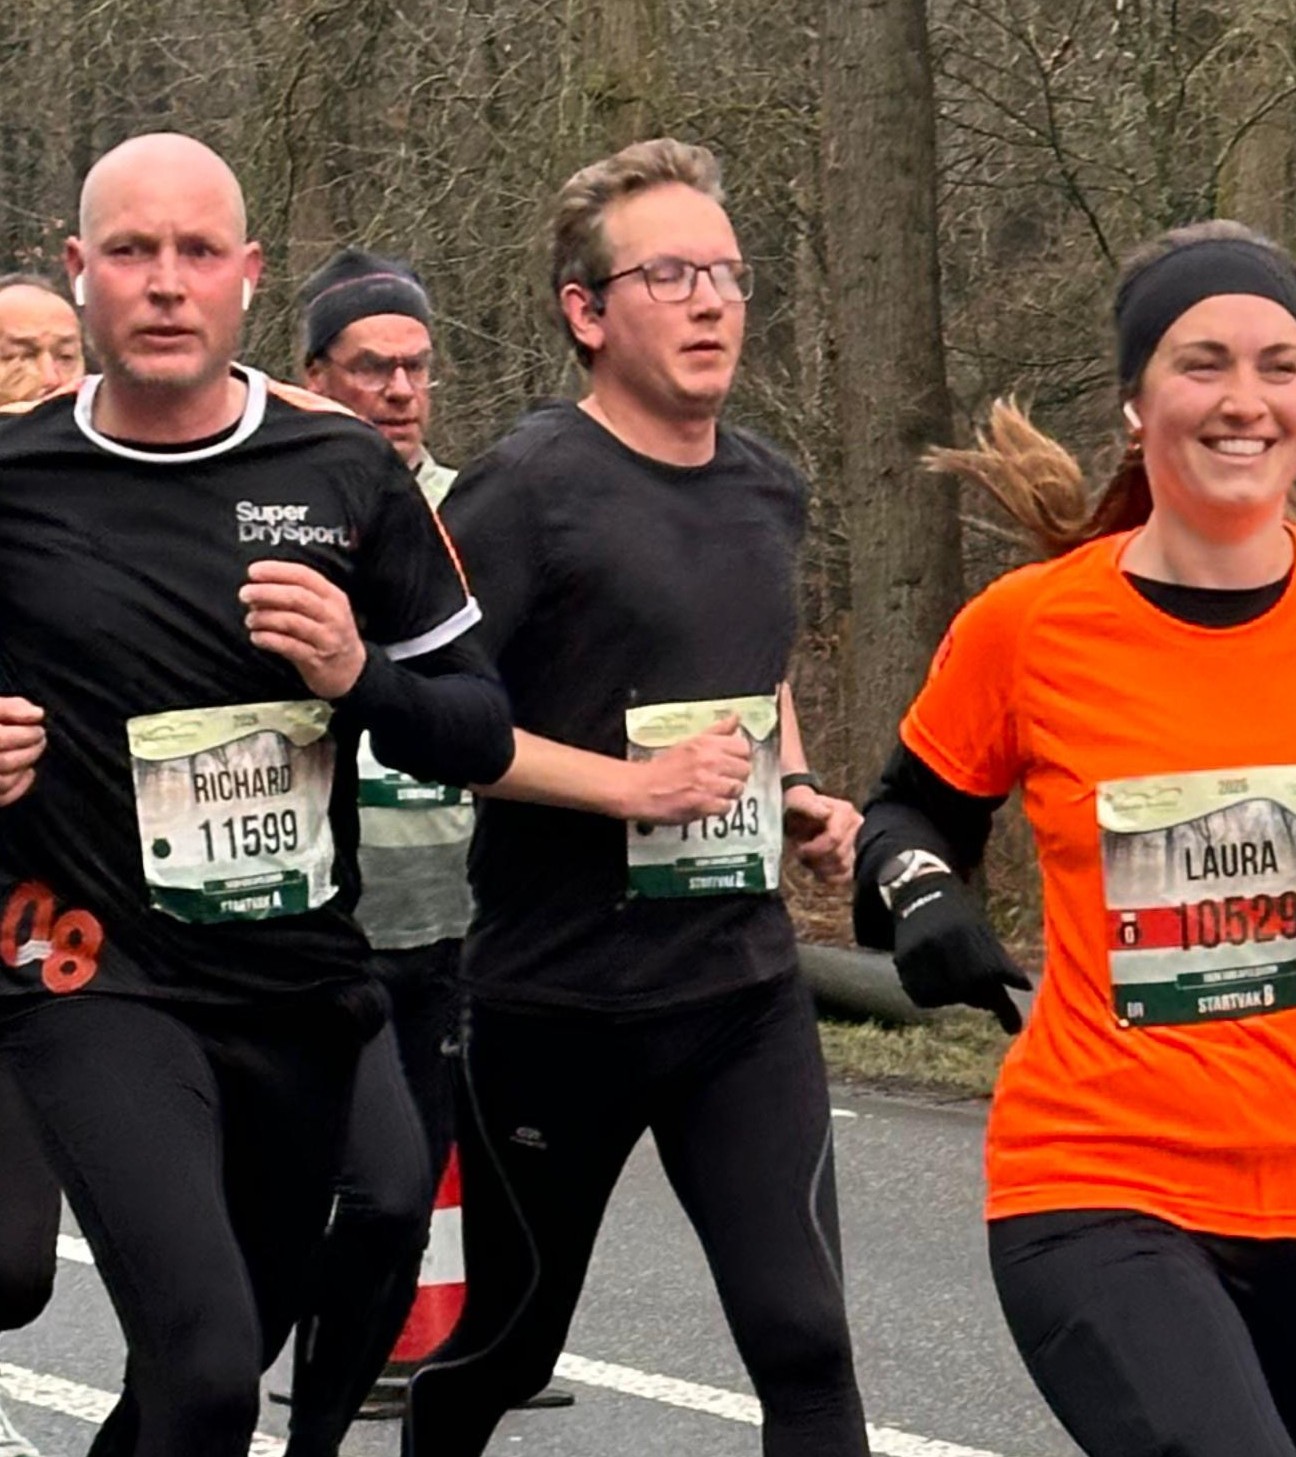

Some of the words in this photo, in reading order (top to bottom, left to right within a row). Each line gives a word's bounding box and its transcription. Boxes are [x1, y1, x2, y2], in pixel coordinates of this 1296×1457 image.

[235, 500, 309, 526] Super
[193, 764, 293, 804] RICHARD
[198, 809, 299, 863] 11599
[1184, 840, 1279, 881] LAURA
[1198, 990, 1263, 1013] STARTVAK
[1263, 983, 1275, 1007] B
